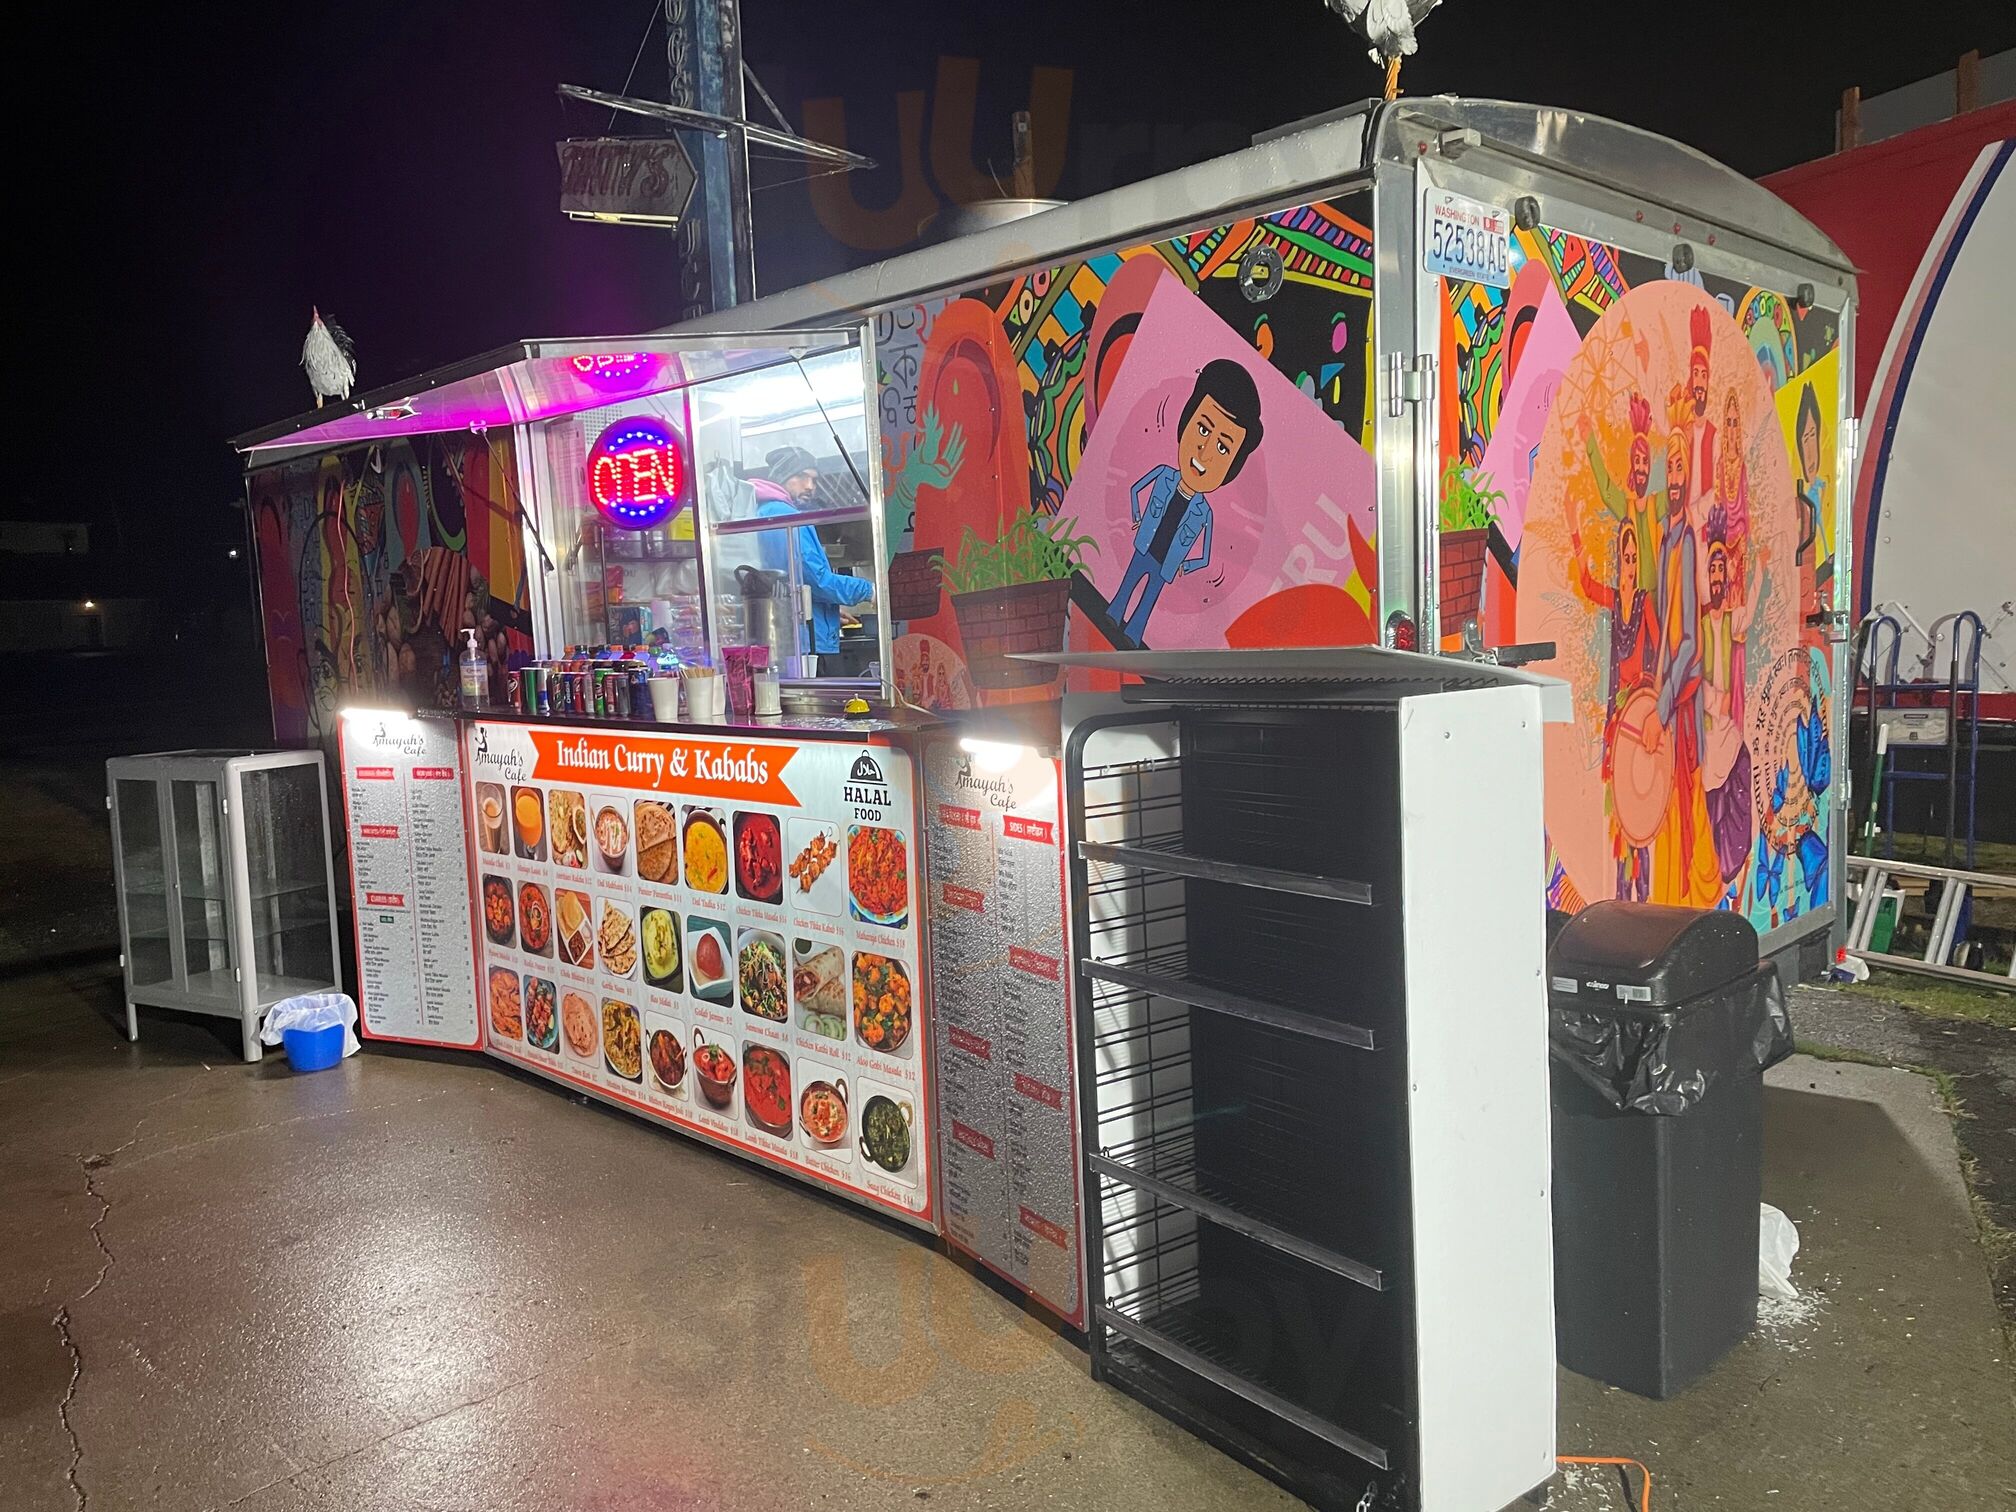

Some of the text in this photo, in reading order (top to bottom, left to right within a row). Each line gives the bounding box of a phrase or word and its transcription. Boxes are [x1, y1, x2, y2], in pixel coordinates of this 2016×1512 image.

[1435, 204, 1480, 226] WASHINGTON
[1432, 218, 1507, 273] 52538AG
[556, 736, 769, 789] Indian Curry & Kababs
[504, 767, 528, 785] Cafe
[843, 786, 893, 807] HALAL
[990, 794, 1018, 813] Cafe
[854, 807, 882, 822] FOOD
[793, 916, 808, 928] Chicken
[877, 932, 895, 946] Chicken
[796, 1035, 814, 1050] Chicken
